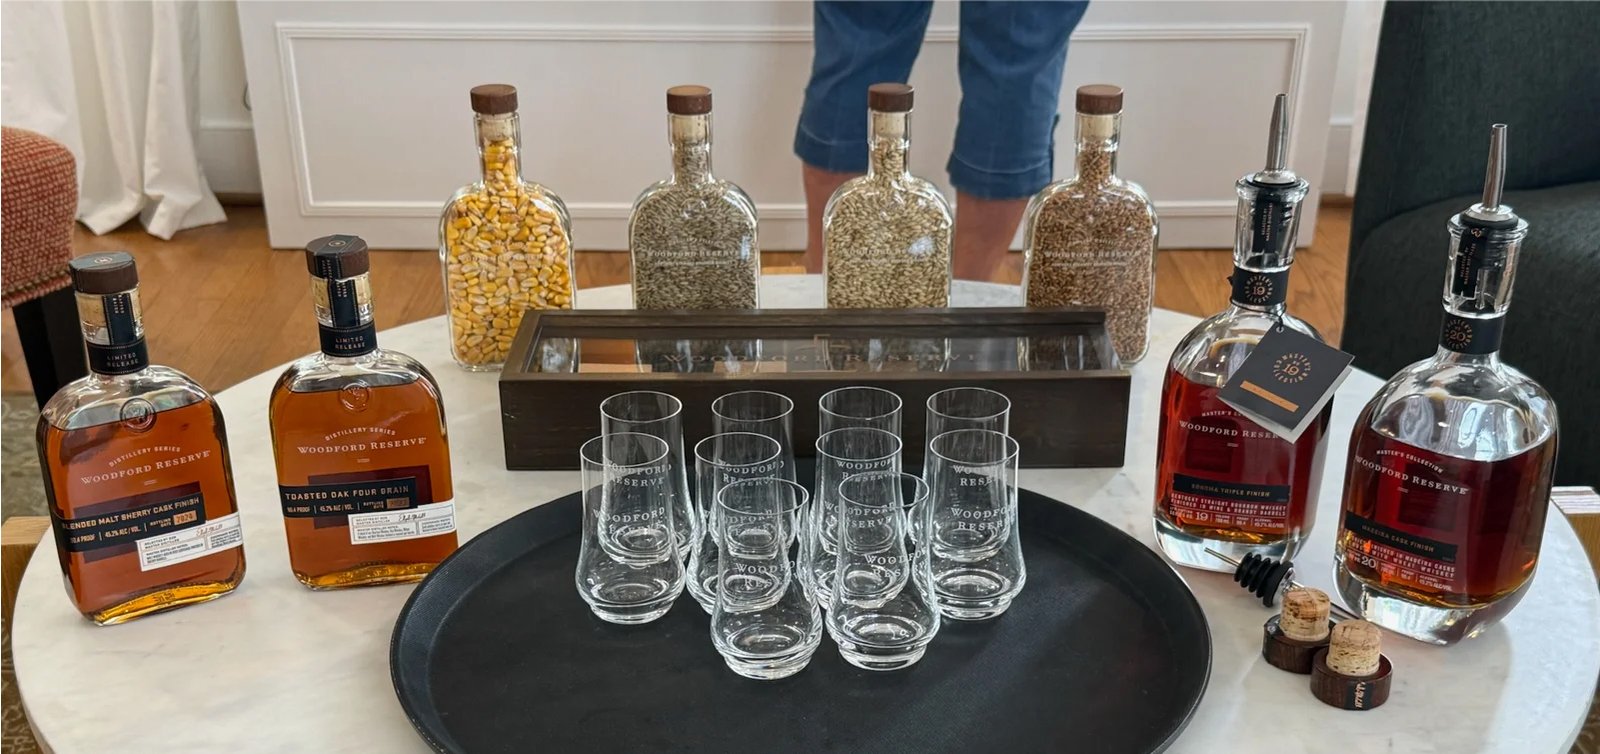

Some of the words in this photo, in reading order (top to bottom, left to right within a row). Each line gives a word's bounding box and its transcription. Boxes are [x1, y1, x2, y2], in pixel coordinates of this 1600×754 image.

[1252, 286, 1265, 296] 19
[1450, 330, 1466, 342] 20
[107, 353, 136, 361] LIMITED
[107, 359, 139, 368] RELEASE
[1282, 363, 1300, 376] 19
[325, 427, 367, 441] DISTILLERY
[370, 427, 396, 436] SERIES
[1180, 420, 1238, 437] WOODFORD
[1242, 430, 1279, 439] RESER
[297, 443, 366, 454] WOODFORD
[370, 437, 426, 450] RESERVE
[108, 447, 152, 468] DISTILLERY
[1376, 449, 1404, 458] MASTER'S
[1406, 453, 1444, 474] COLLECTION
[81, 464, 152, 485] WOODFORD
[155, 450, 210, 470] RESERVE
[1355, 455, 1409, 481] WOODFORD
[1412, 475, 1469, 495] RESERVE
[285, 491, 328, 501] TOASTED
[331, 490, 350, 499] OAK
[353, 487, 378, 497] FOUR
[380, 485, 410, 495] GRAIN
[1221, 488, 1244, 496] TRIPLE
[1171, 493, 1198, 502] KENTUCKY
[1201, 498, 1229, 507] STRAIGHT
[1231, 502, 1258, 510] BOURBON
[62, 518, 97, 531] BLENDED
[98, 515, 120, 526] MALT
[120, 508, 152, 521] SHERRY
[153, 504, 174, 514] CASK
[175, 496, 200, 509] FINISH
[176, 513, 193, 523] 2024
[1195, 512, 1209, 521] 19
[1391, 535, 1409, 546] CASK
[1410, 541, 1434, 552] FINISH
[1361, 555, 1377, 568] 20
[1405, 555, 1432, 568] MADEIRA
[1434, 563, 1455, 573] CASKS
